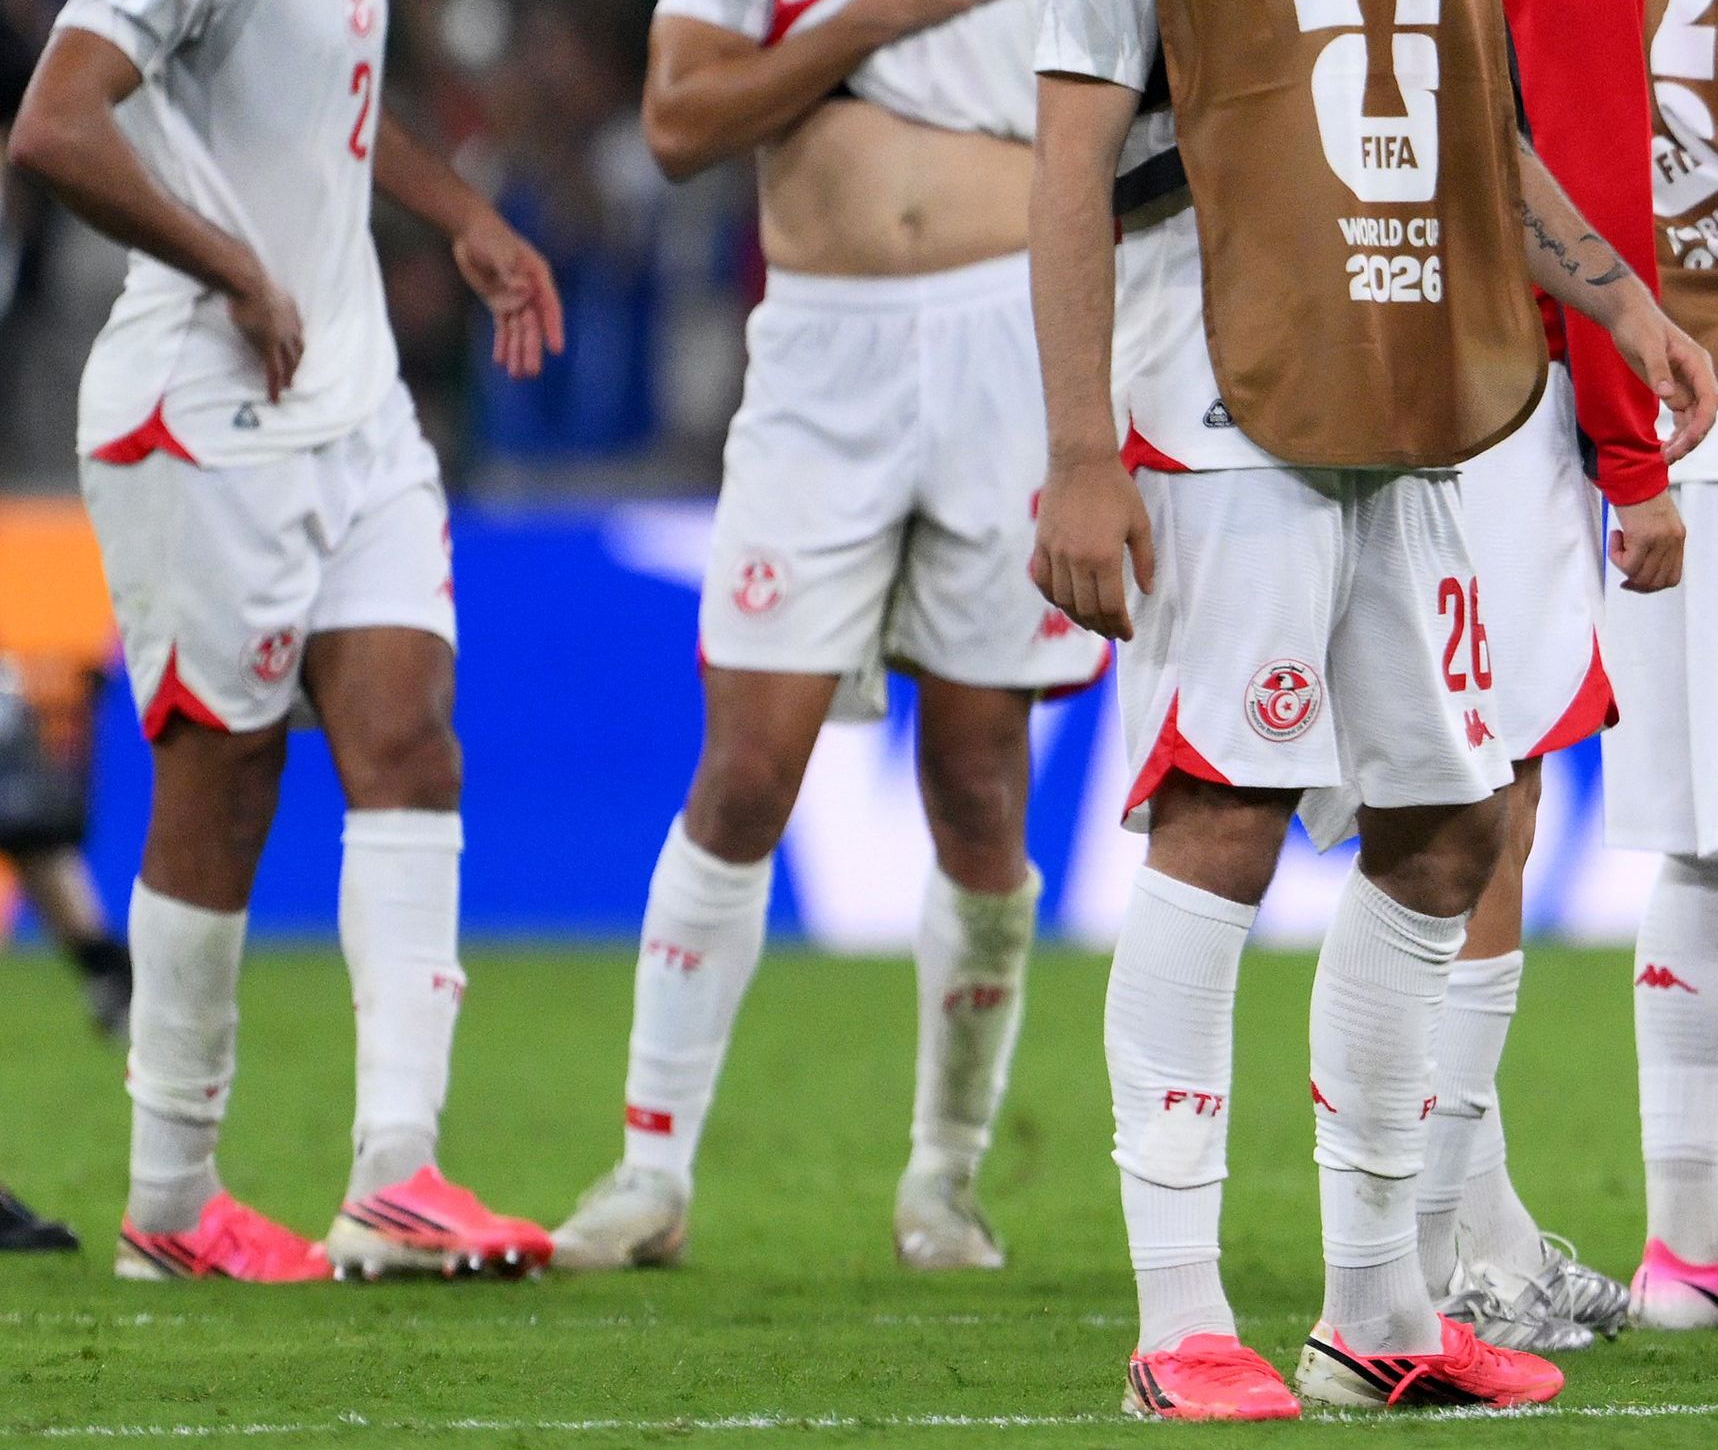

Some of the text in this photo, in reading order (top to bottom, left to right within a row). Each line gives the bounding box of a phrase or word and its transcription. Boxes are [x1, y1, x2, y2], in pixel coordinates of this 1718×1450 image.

[1360, 136, 1418, 169] FIFA
[1337, 217, 1403, 247] WORLD
[1345, 253, 1442, 303] 2026
[1438, 575, 1493, 693] 26
